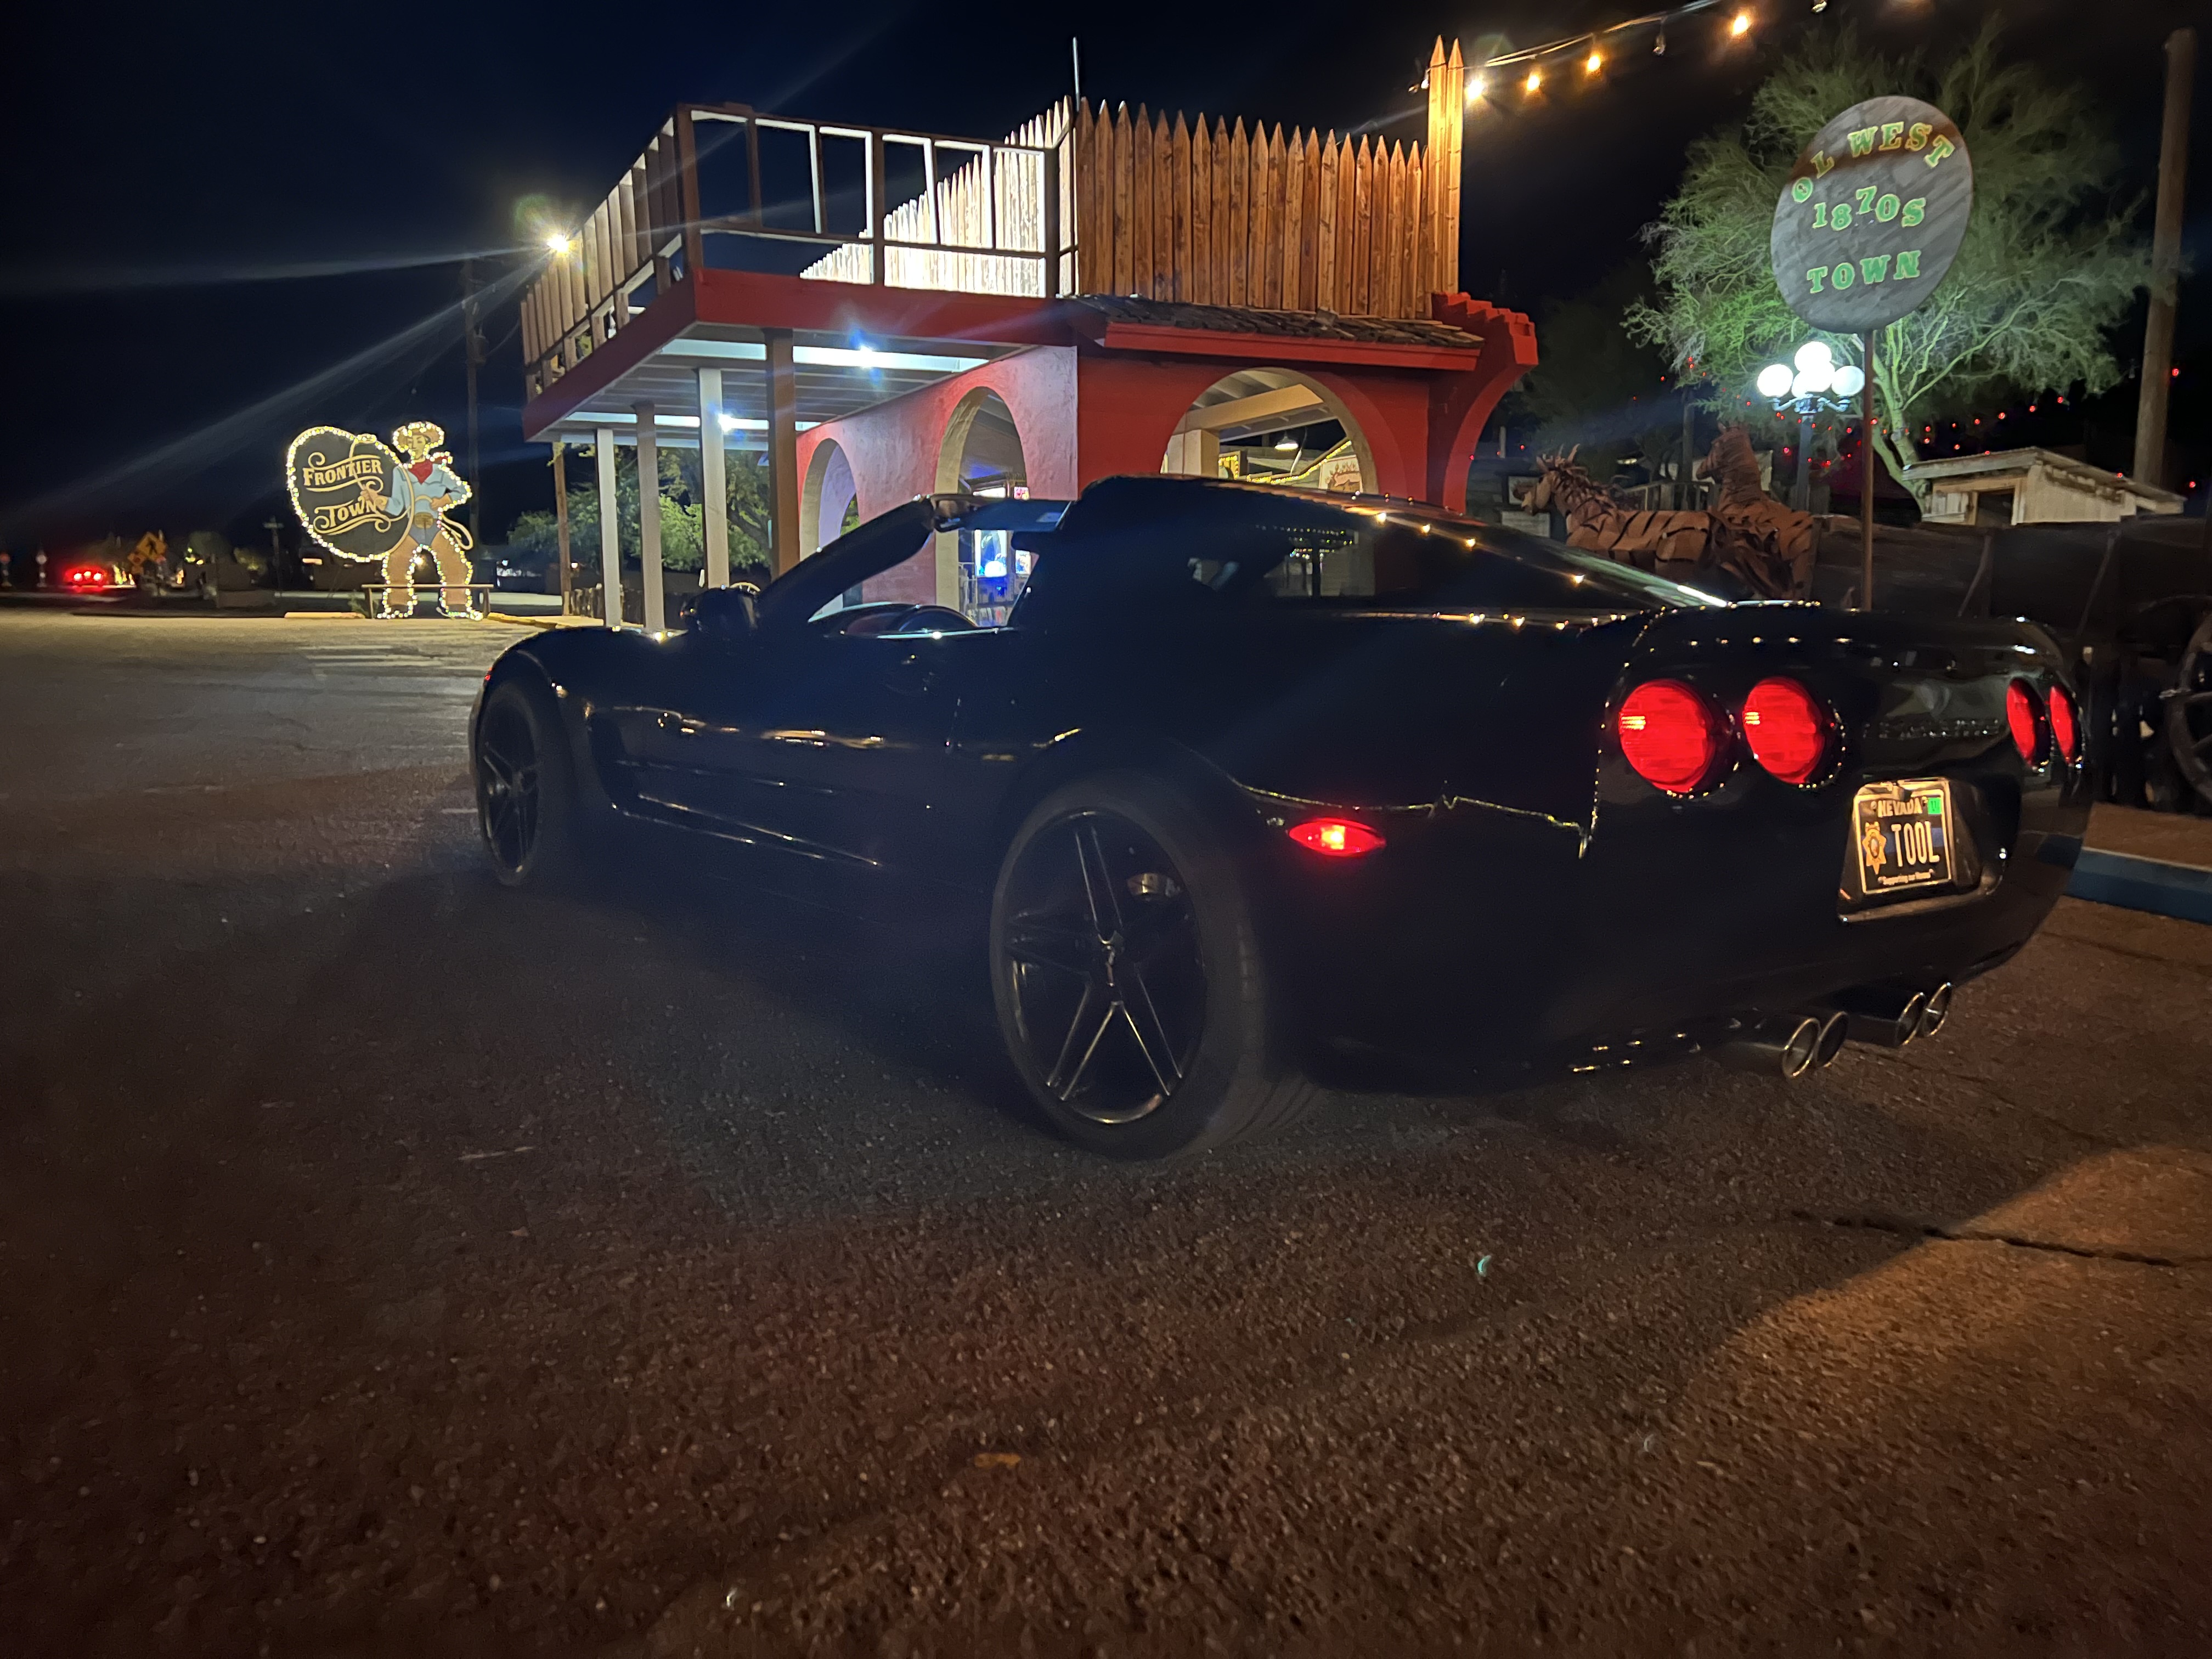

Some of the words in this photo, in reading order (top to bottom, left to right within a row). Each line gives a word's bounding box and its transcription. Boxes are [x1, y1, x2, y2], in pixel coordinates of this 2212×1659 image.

[1847, 121, 1956, 168] WEST
[1807, 250, 1922, 294] TOWN
[302, 459, 383, 486] FRONTIER
[314, 495, 387, 528] TOWN
[1877, 797, 1923, 818] NEVADA
[1891, 821, 1940, 867] TOOL
